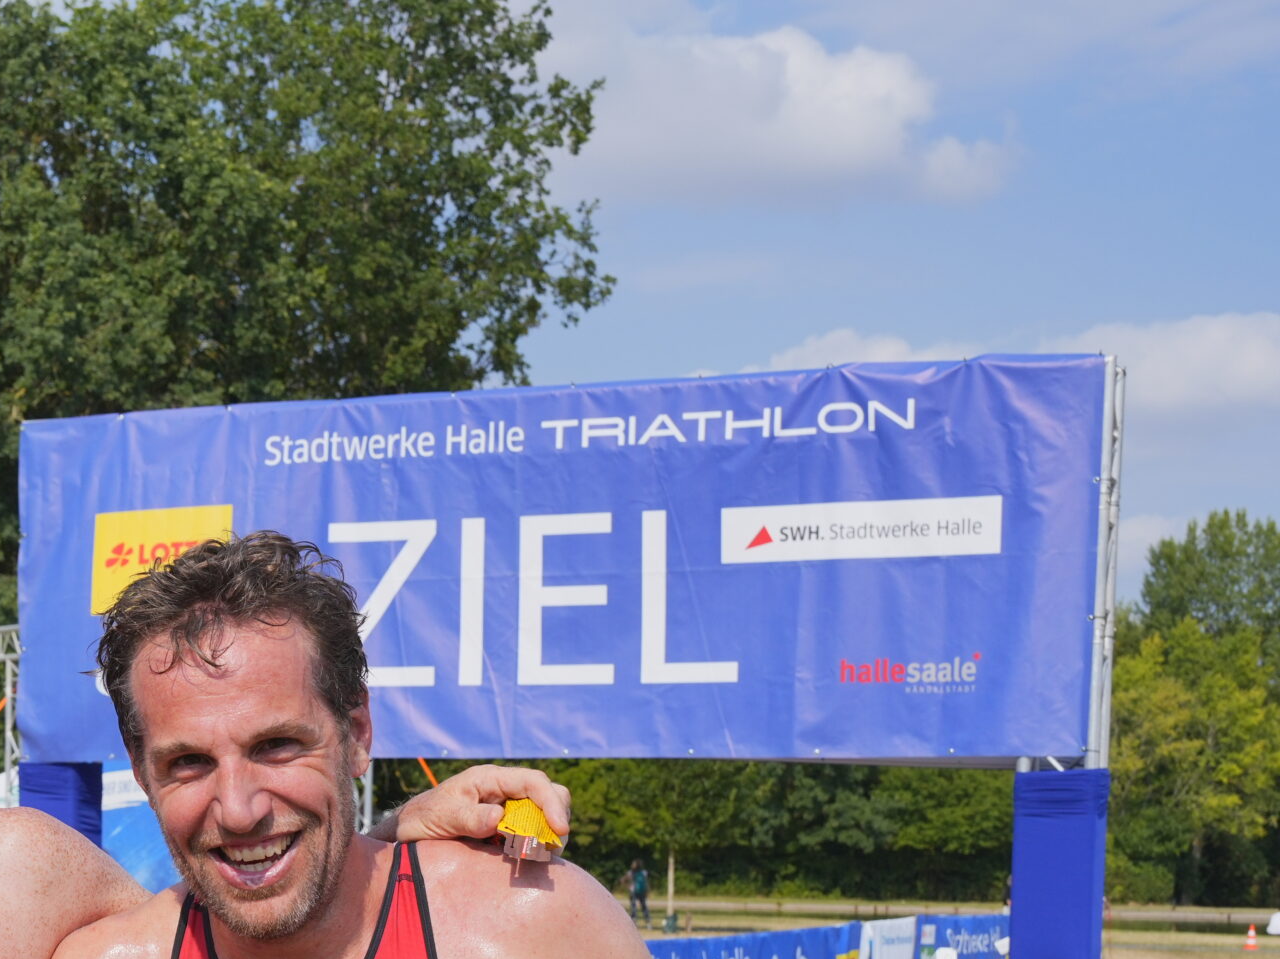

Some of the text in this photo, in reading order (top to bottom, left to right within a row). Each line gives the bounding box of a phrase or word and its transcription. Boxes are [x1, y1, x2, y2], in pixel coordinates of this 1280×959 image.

[264, 397, 916, 466] Stadtwerke Halle TRIATHLON
[779, 518, 983, 542] SWH. Stadtwerke Halle
[326, 508, 739, 687] ZIEL
